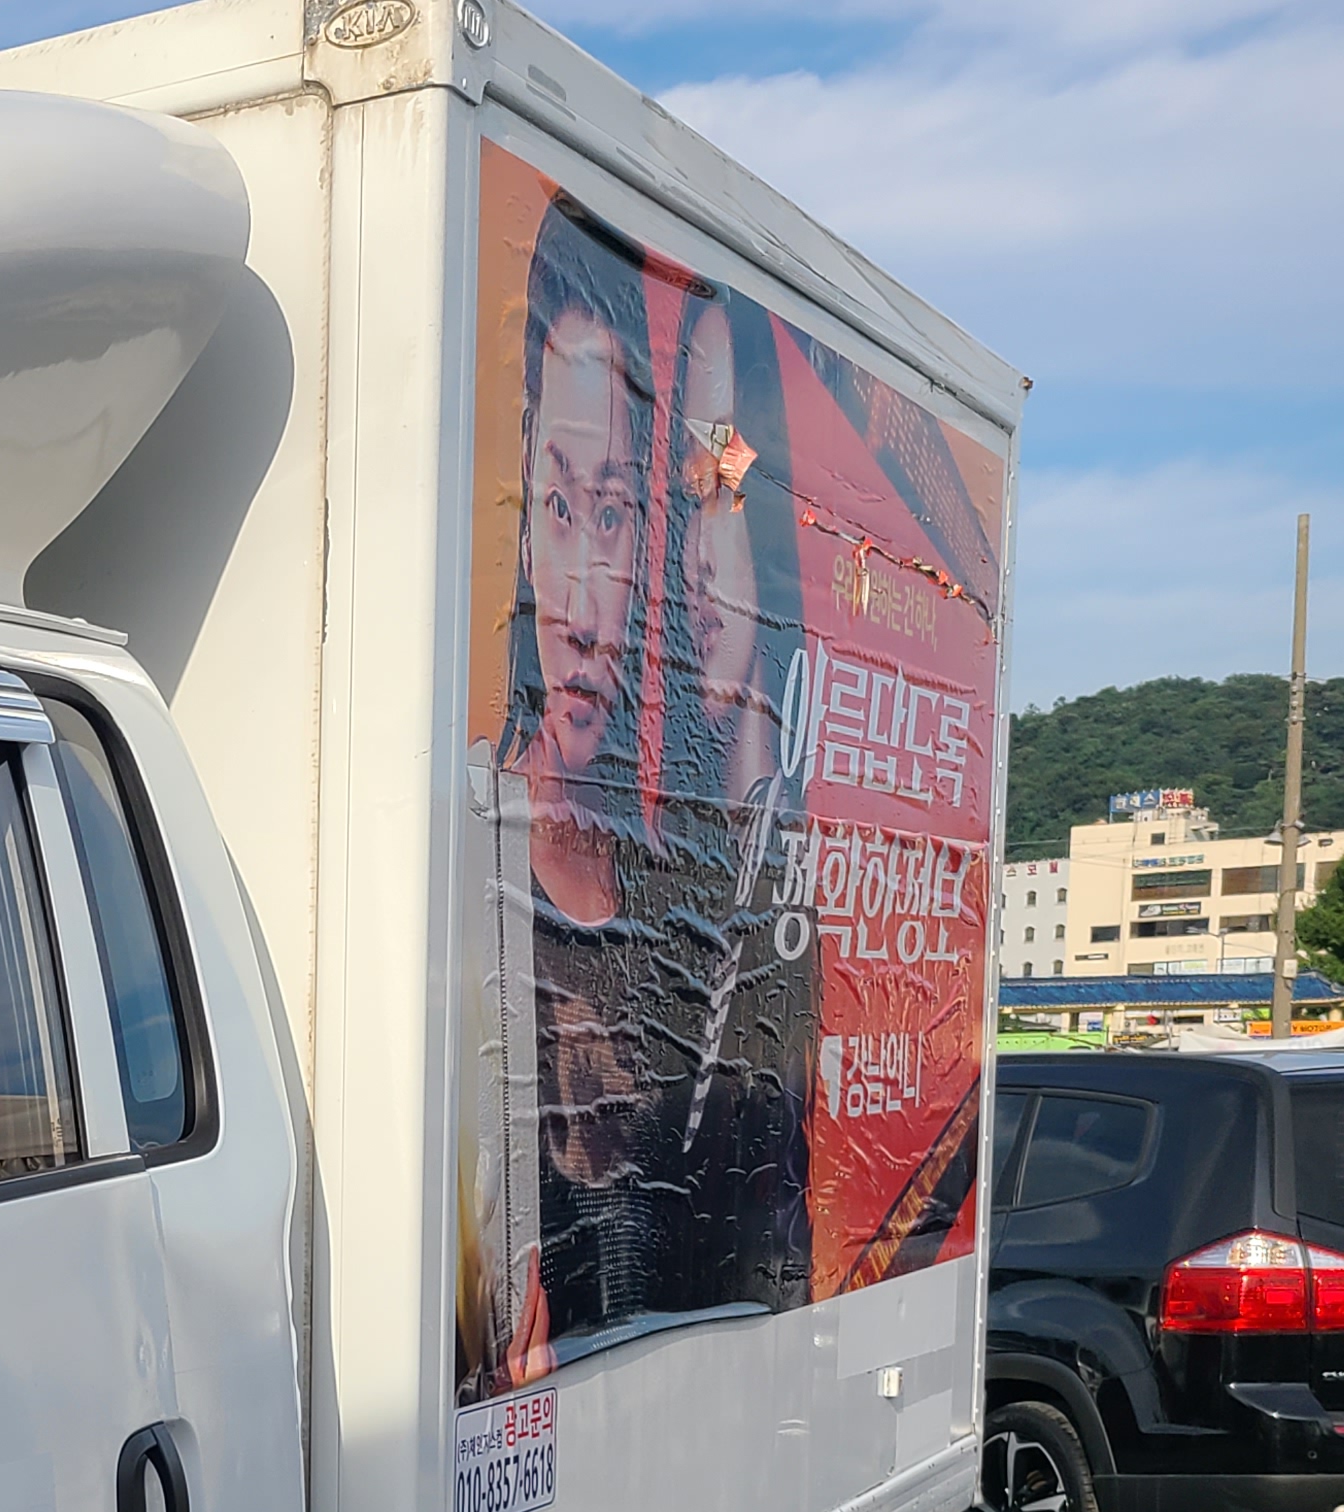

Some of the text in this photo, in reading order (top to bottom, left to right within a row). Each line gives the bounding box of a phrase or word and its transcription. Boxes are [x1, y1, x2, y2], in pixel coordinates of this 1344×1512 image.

[342, 5, 400, 41] KIA
[831, 554, 869, 616] 우리
[780, 636, 971, 808] 아름답도록
[846, 1030, 924, 1119] 강남언니
[504, 1392, 554, 1448] 광고문의
